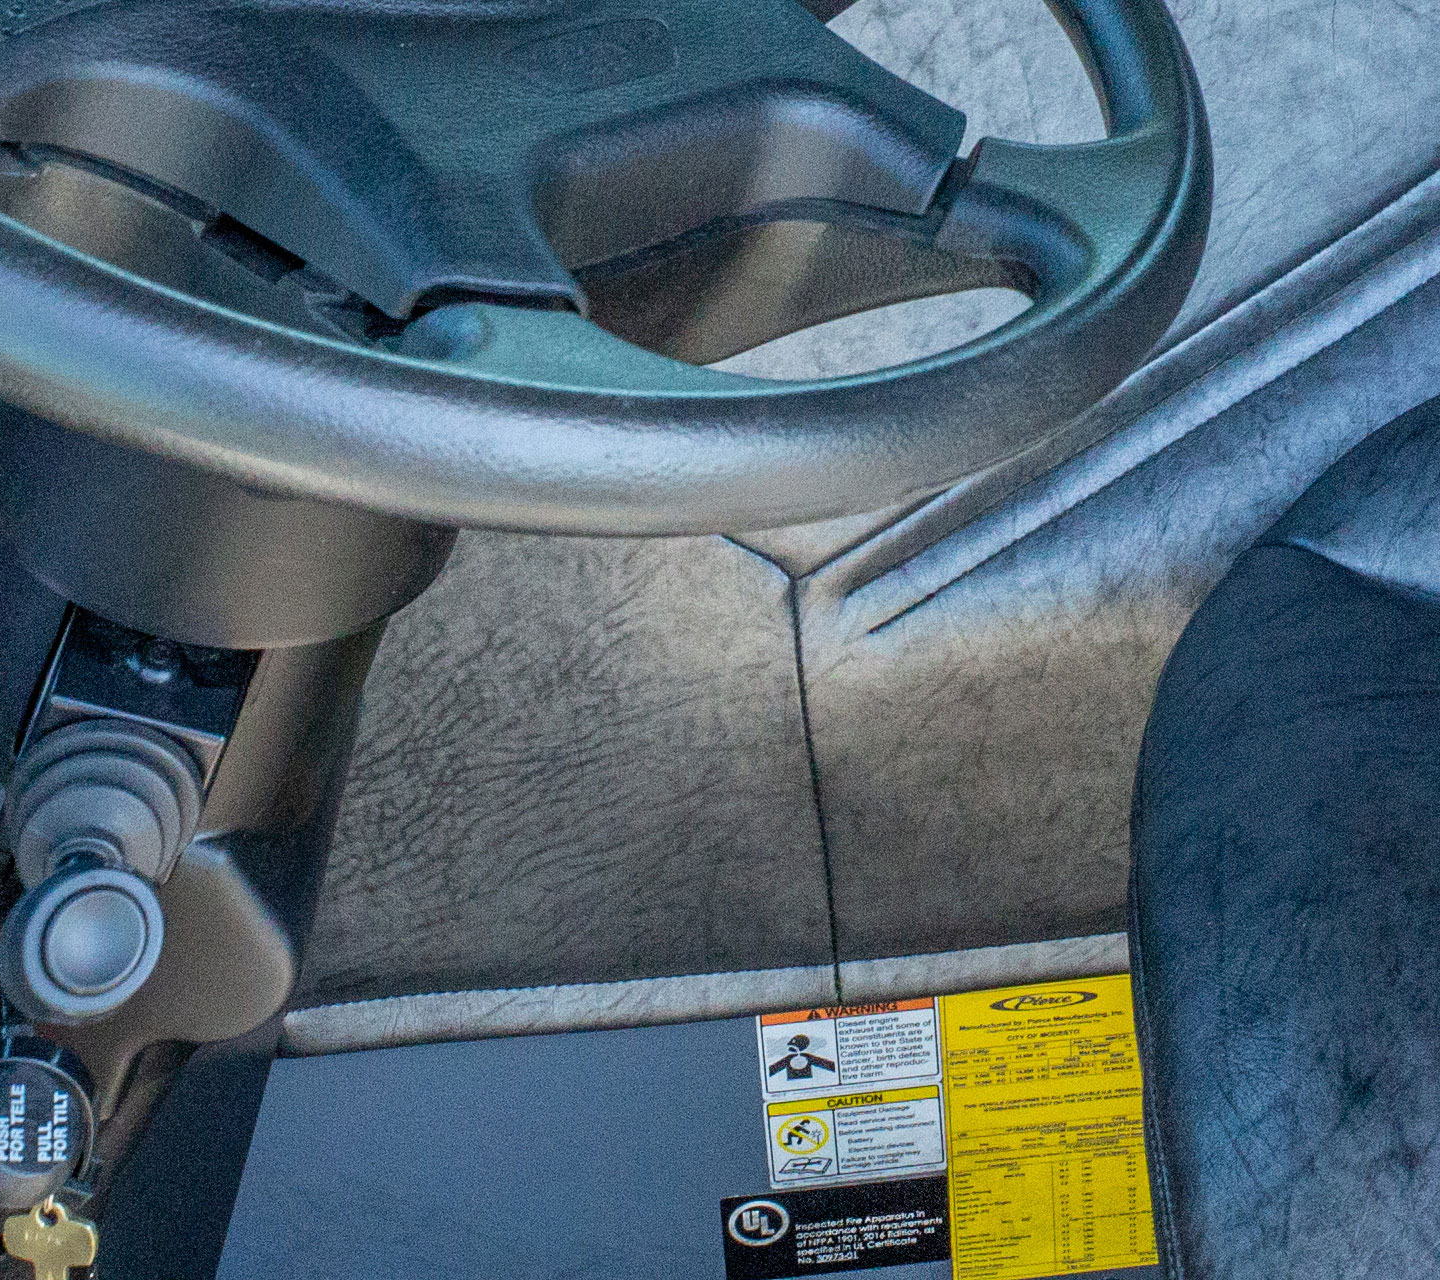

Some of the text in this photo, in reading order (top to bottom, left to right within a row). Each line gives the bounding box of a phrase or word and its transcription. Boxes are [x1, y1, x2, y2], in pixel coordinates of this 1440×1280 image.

[825, 1002, 898, 1017] WARNING
[838, 1016, 899, 1028] Diesel engine
[839, 1026, 874, 1035] exhaust
[895, 1022, 920, 1030] some
[840, 1042, 868, 1050] known
[899, 1035, 923, 1043] State
[852, 1030, 905, 1041] constituents
[841, 1048, 883, 1058] California
[827, 1094, 883, 1108] CAUTION
[10, 1083, 26, 1163] FOR TELE
[53, 1090, 69, 1162] FOR TILT
[37, 1120, 52, 1163] PULL
[795, 1218, 844, 1231] Inspected
[846, 1217, 863, 1225] Fire
[865, 1213, 914, 1225] Apparatus
[796, 1217, 943, 1239] accordance with requirements
